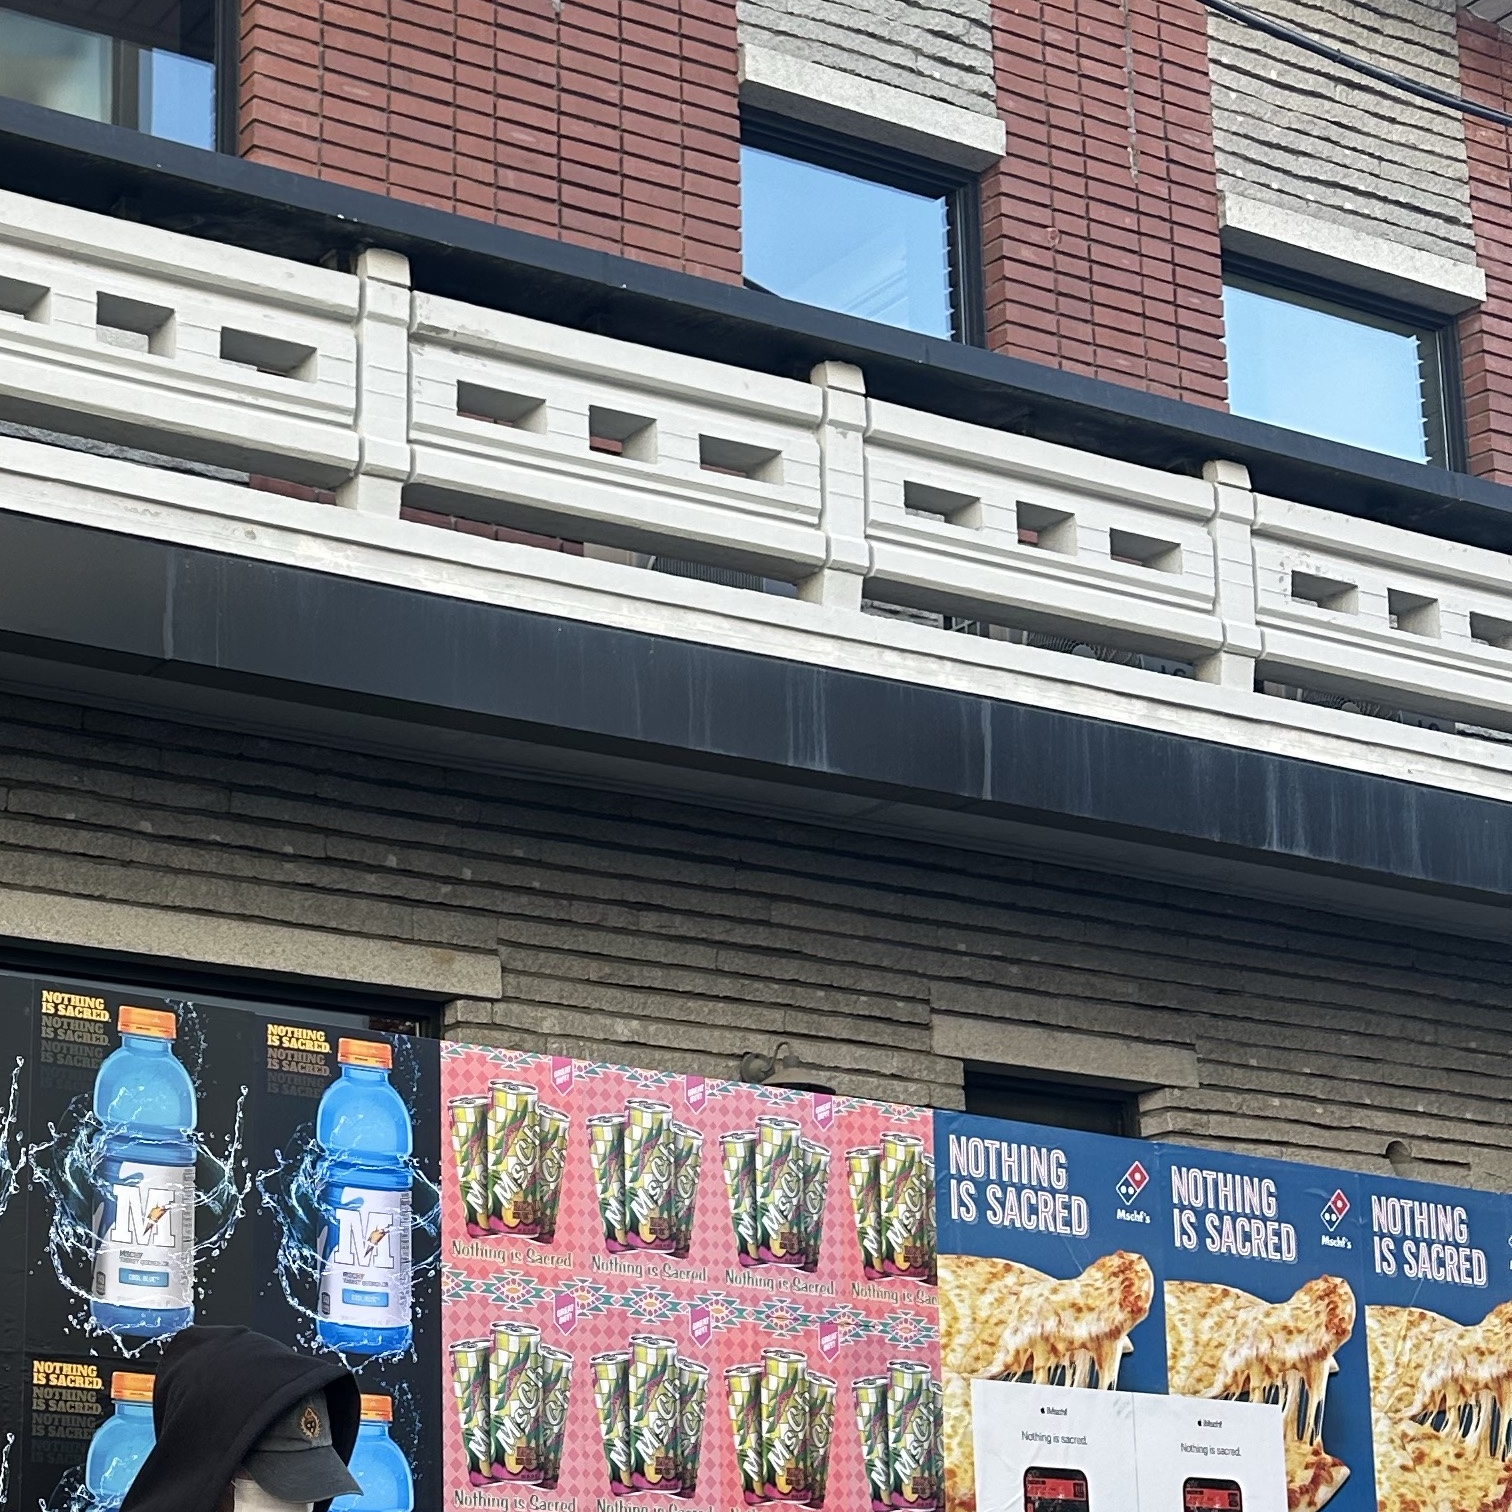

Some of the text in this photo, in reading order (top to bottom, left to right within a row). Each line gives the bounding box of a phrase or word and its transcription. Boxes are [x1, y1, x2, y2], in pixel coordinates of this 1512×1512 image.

[41, 990, 105, 1010] NOTHING
[41, 1002, 112, 1023] IS SACRED.
[267, 1024, 326, 1042] NOTHING
[267, 1035, 333, 1054] IS SACRED.
[949, 1134, 1067, 1189] NOTHING
[1171, 1166, 1276, 1218] NOTHING
[949, 1178, 1090, 1238] IS SACRED
[1117, 1209, 1151, 1225] Mschf's
[1372, 1194, 1469, 1244] NOTHING
[1173, 1208, 1298, 1264] IS SACRED
[452, 1239, 573, 1269] Nothing is Sacred
[1374, 1236, 1488, 1289] IS SACRED
[1021, 1430, 1051, 1446] Nothing
[1052, 1434, 1059, 1444] is
[514, 1494, 527, 1512] is
